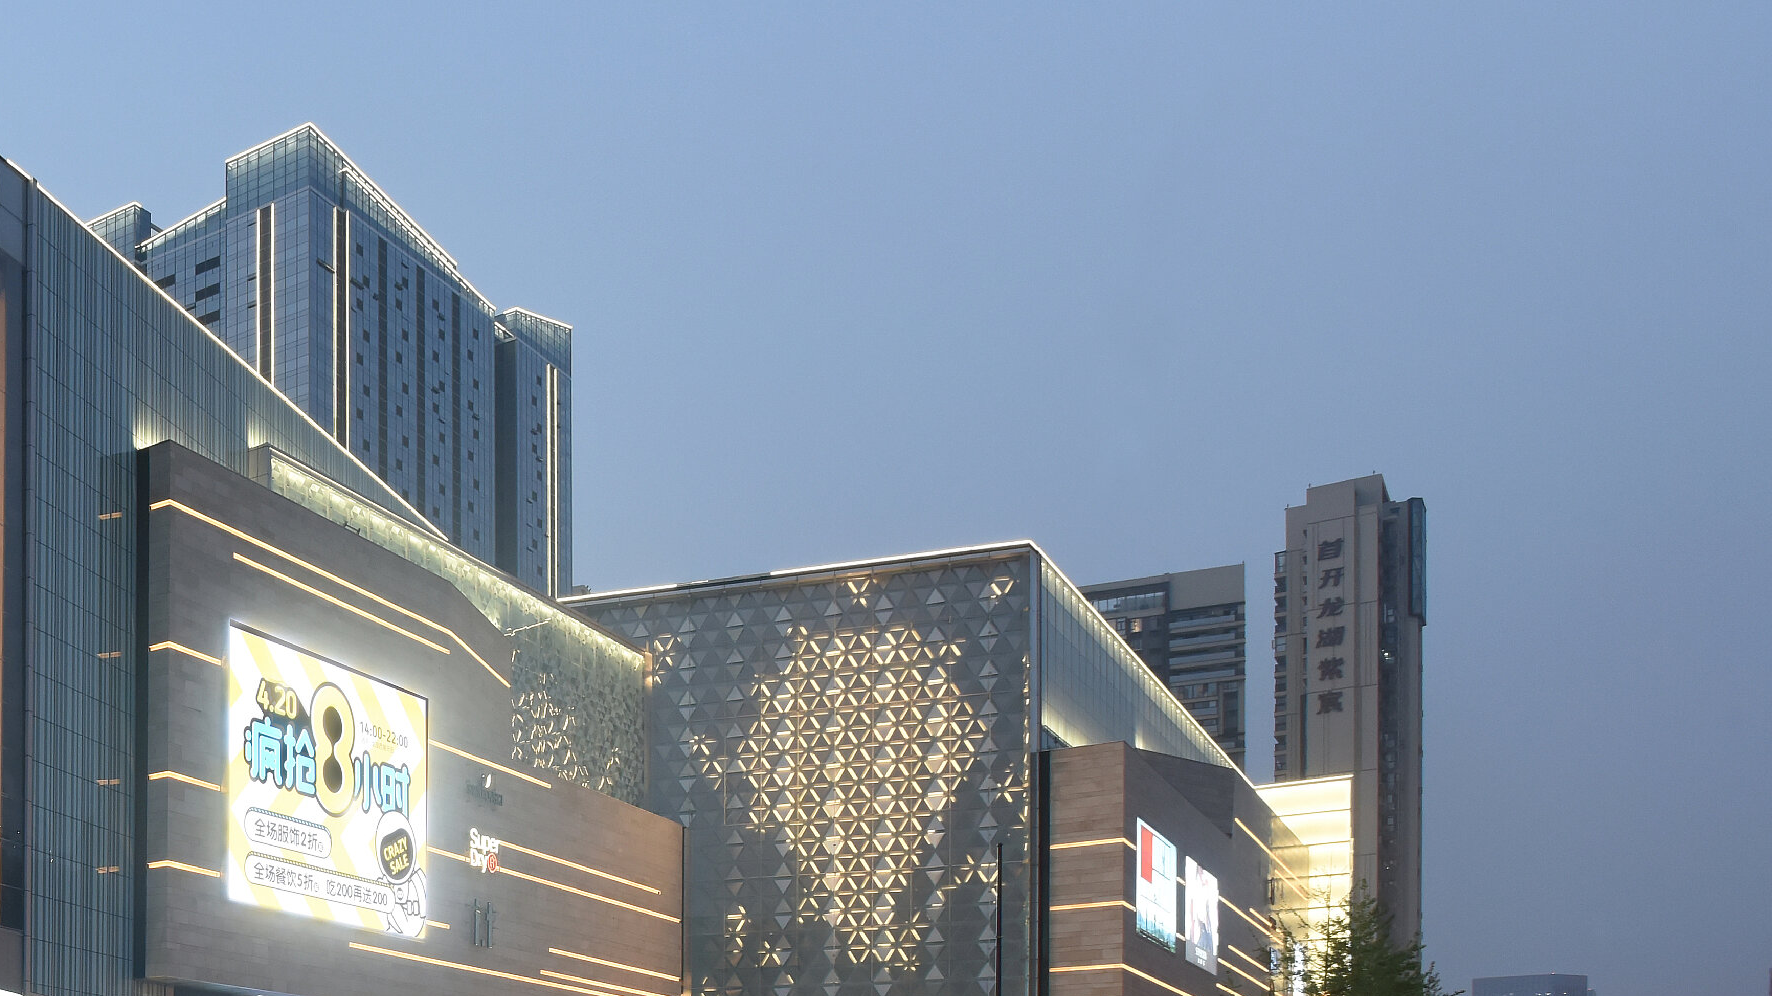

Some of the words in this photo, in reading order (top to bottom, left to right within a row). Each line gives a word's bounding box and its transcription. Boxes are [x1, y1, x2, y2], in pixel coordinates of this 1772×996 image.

[256, 678, 297, 720] 4.20
[383, 836, 408, 861] CRAZY
[389, 853, 410, 875] SALE
